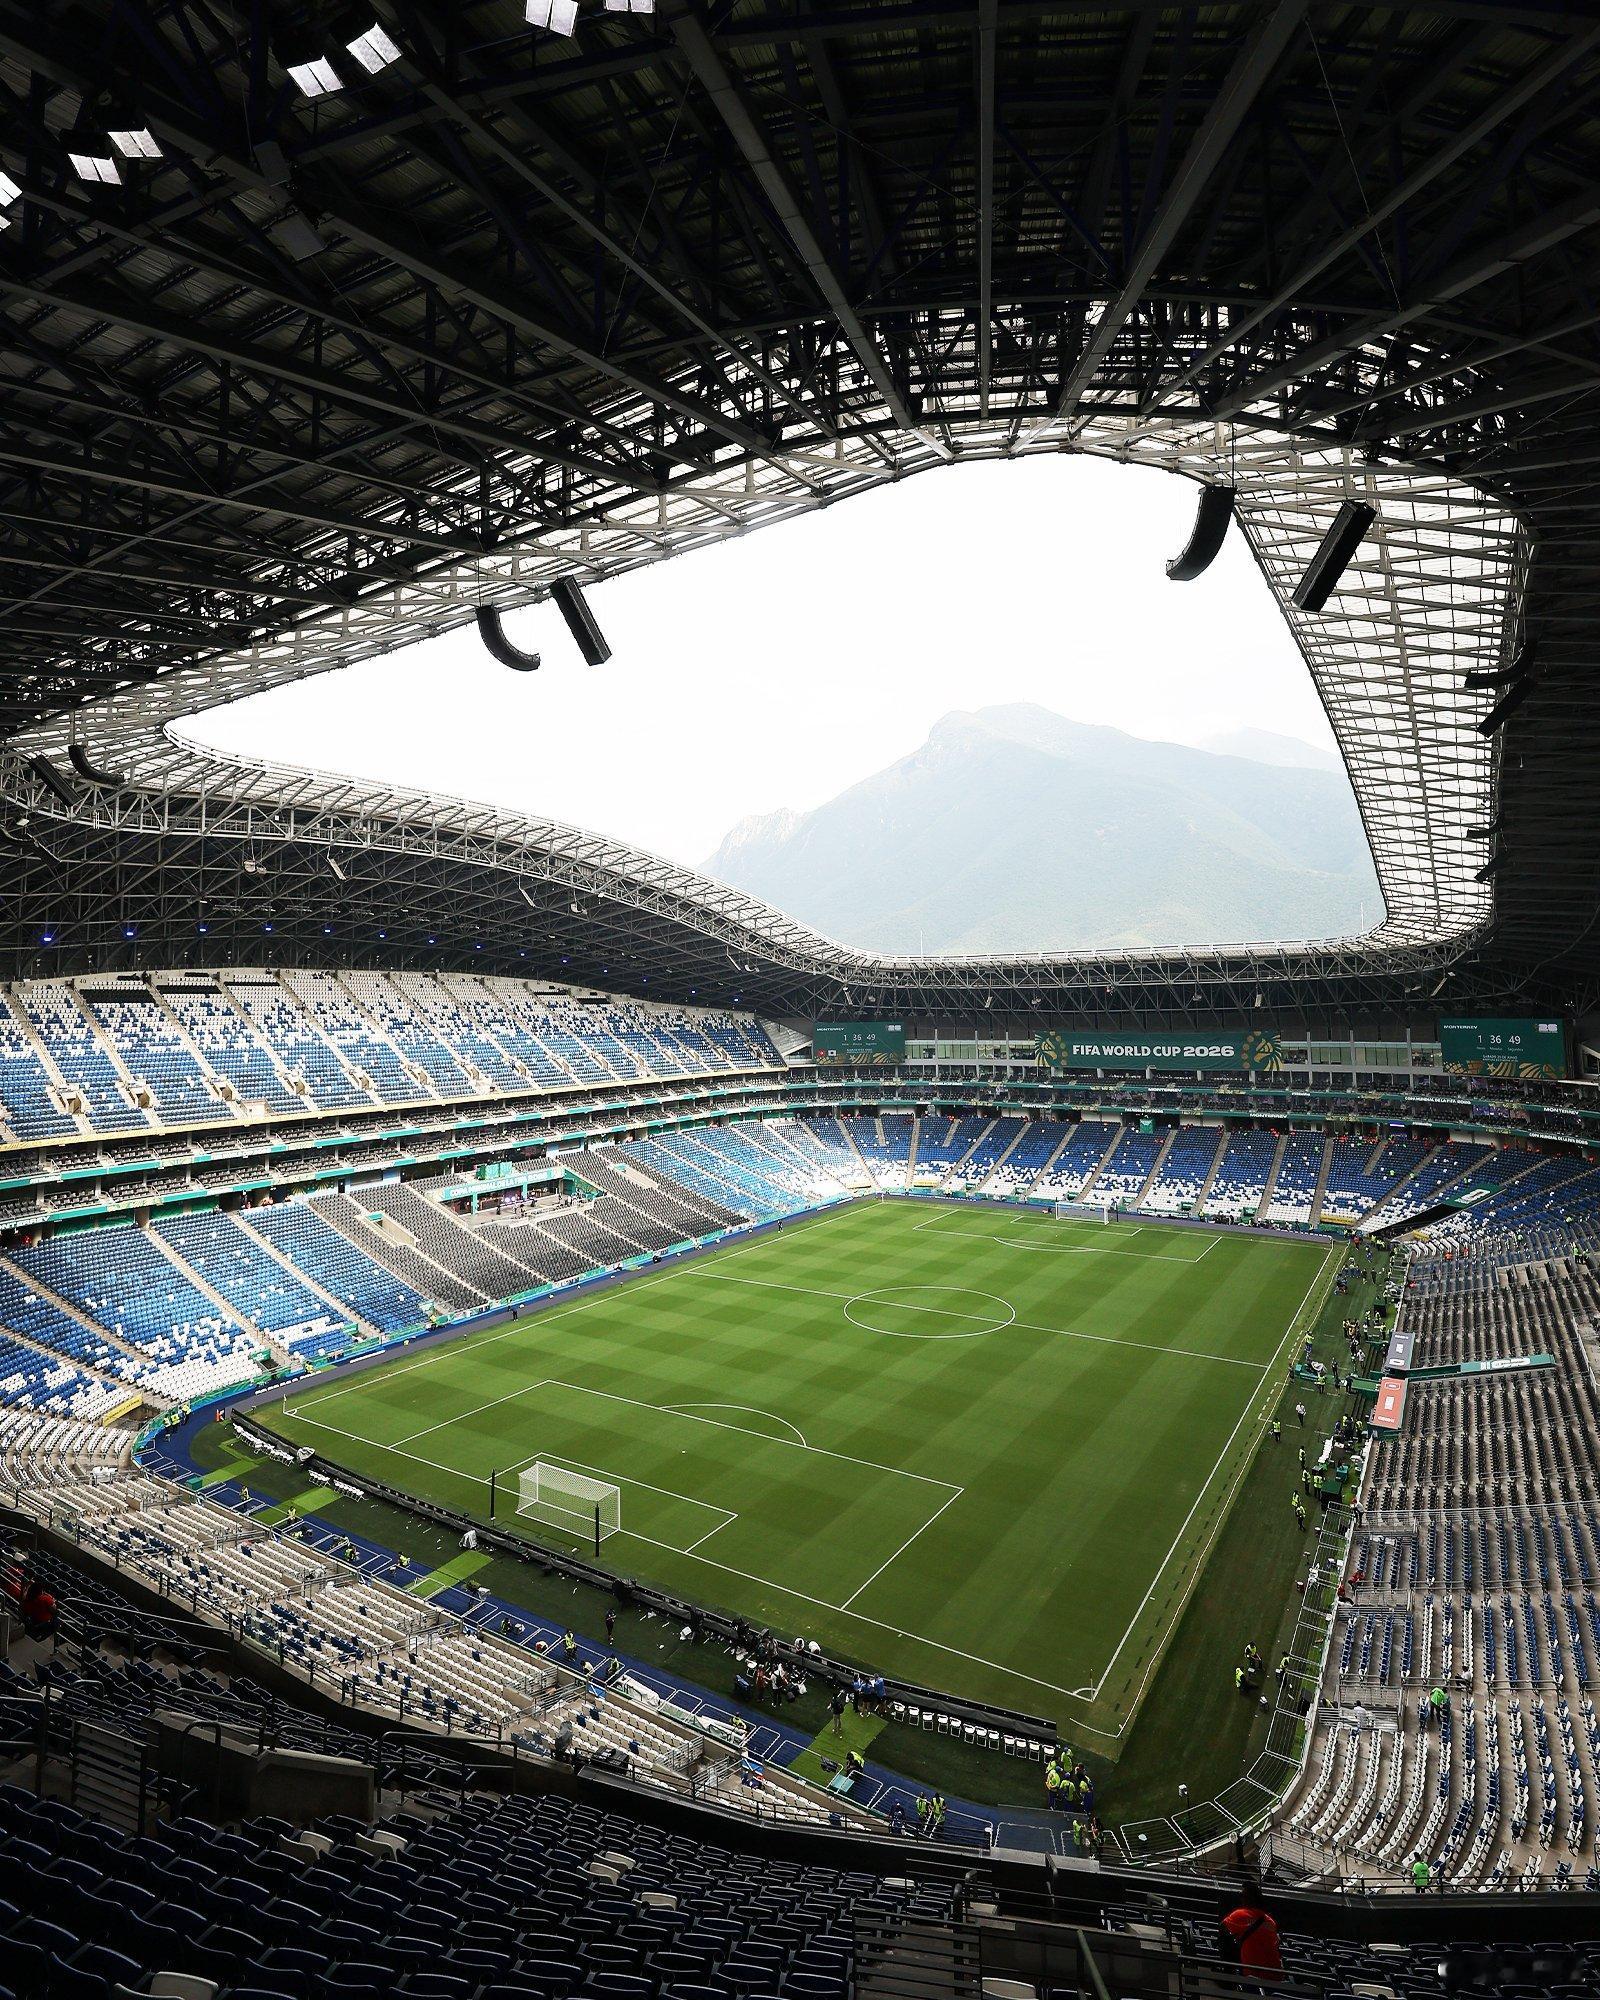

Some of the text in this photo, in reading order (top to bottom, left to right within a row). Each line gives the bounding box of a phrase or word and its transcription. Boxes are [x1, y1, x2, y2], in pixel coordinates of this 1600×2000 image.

[1478, 1034, 1521, 1045] 1 36 49
[1072, 1045, 1235, 1057] FIFA WORLD CUP 2026
[1544, 1107, 1579, 1115] MONTERREY
